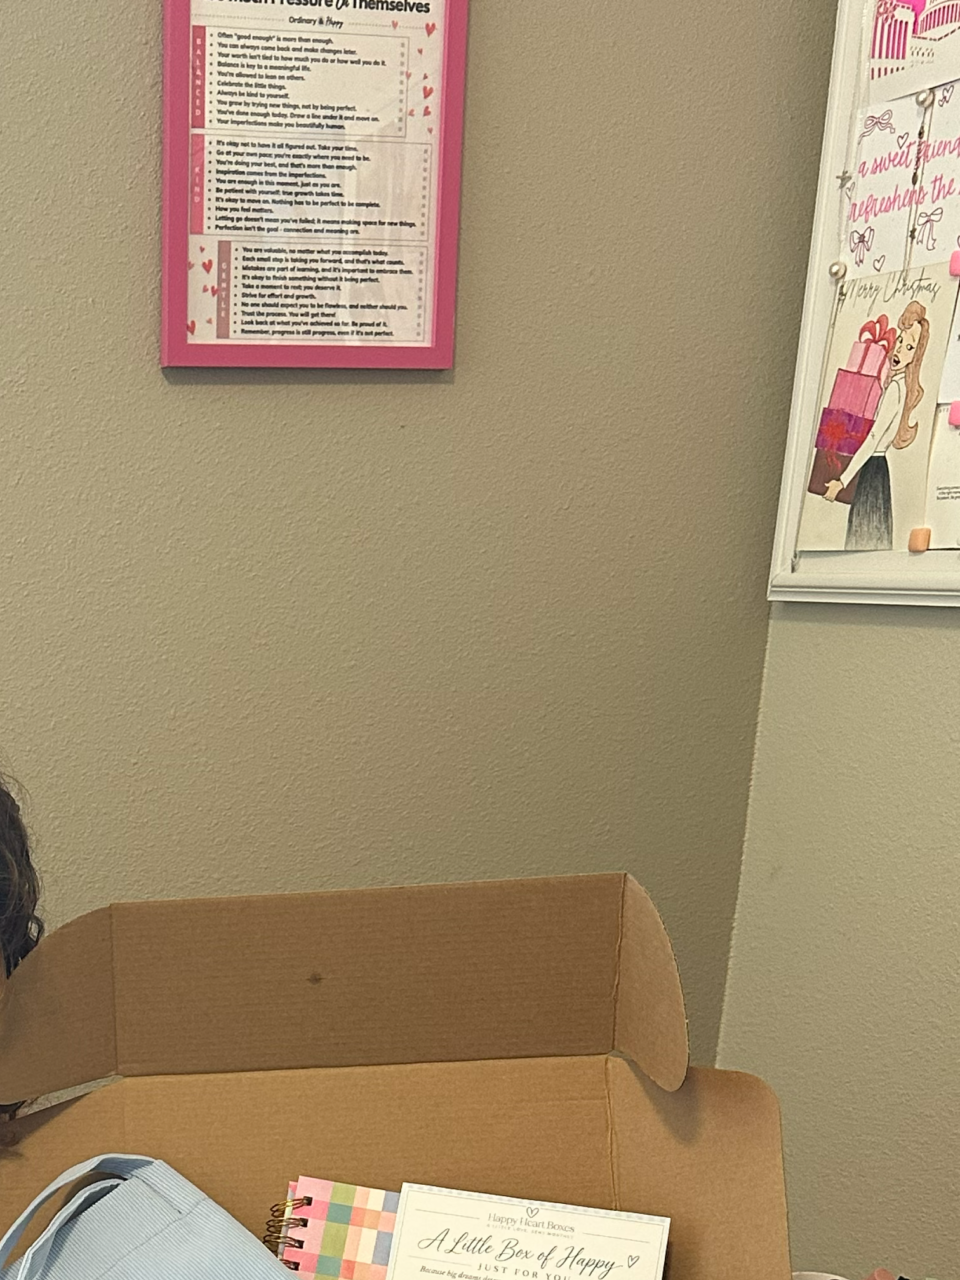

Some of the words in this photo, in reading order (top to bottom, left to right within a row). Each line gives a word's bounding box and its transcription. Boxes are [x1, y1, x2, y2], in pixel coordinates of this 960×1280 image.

[352, 0, 431, 13] Themselves
[288, 16, 317, 26] Ordinary
[858, 161, 869, 178] a
[870, 141, 916, 175] sweet
[931, 173, 956, 204] the
[488, 1213, 518, 1226] Happy
[519, 1217, 545, 1229] Heart
[546, 1221, 575, 1234] Boxes
[417, 1228, 450, 1251] A
[446, 1231, 495, 1255] Little
[495, 1238, 535, 1262] Box
[537, 1245, 558, 1270] of
[556, 1246, 623, 1280] Happy
[419, 1265, 446, 1276] Because
[447, 1269, 458, 1279] big
[477, 1263, 508, 1274] JUST
[514, 1268, 539, 1279] FOR
